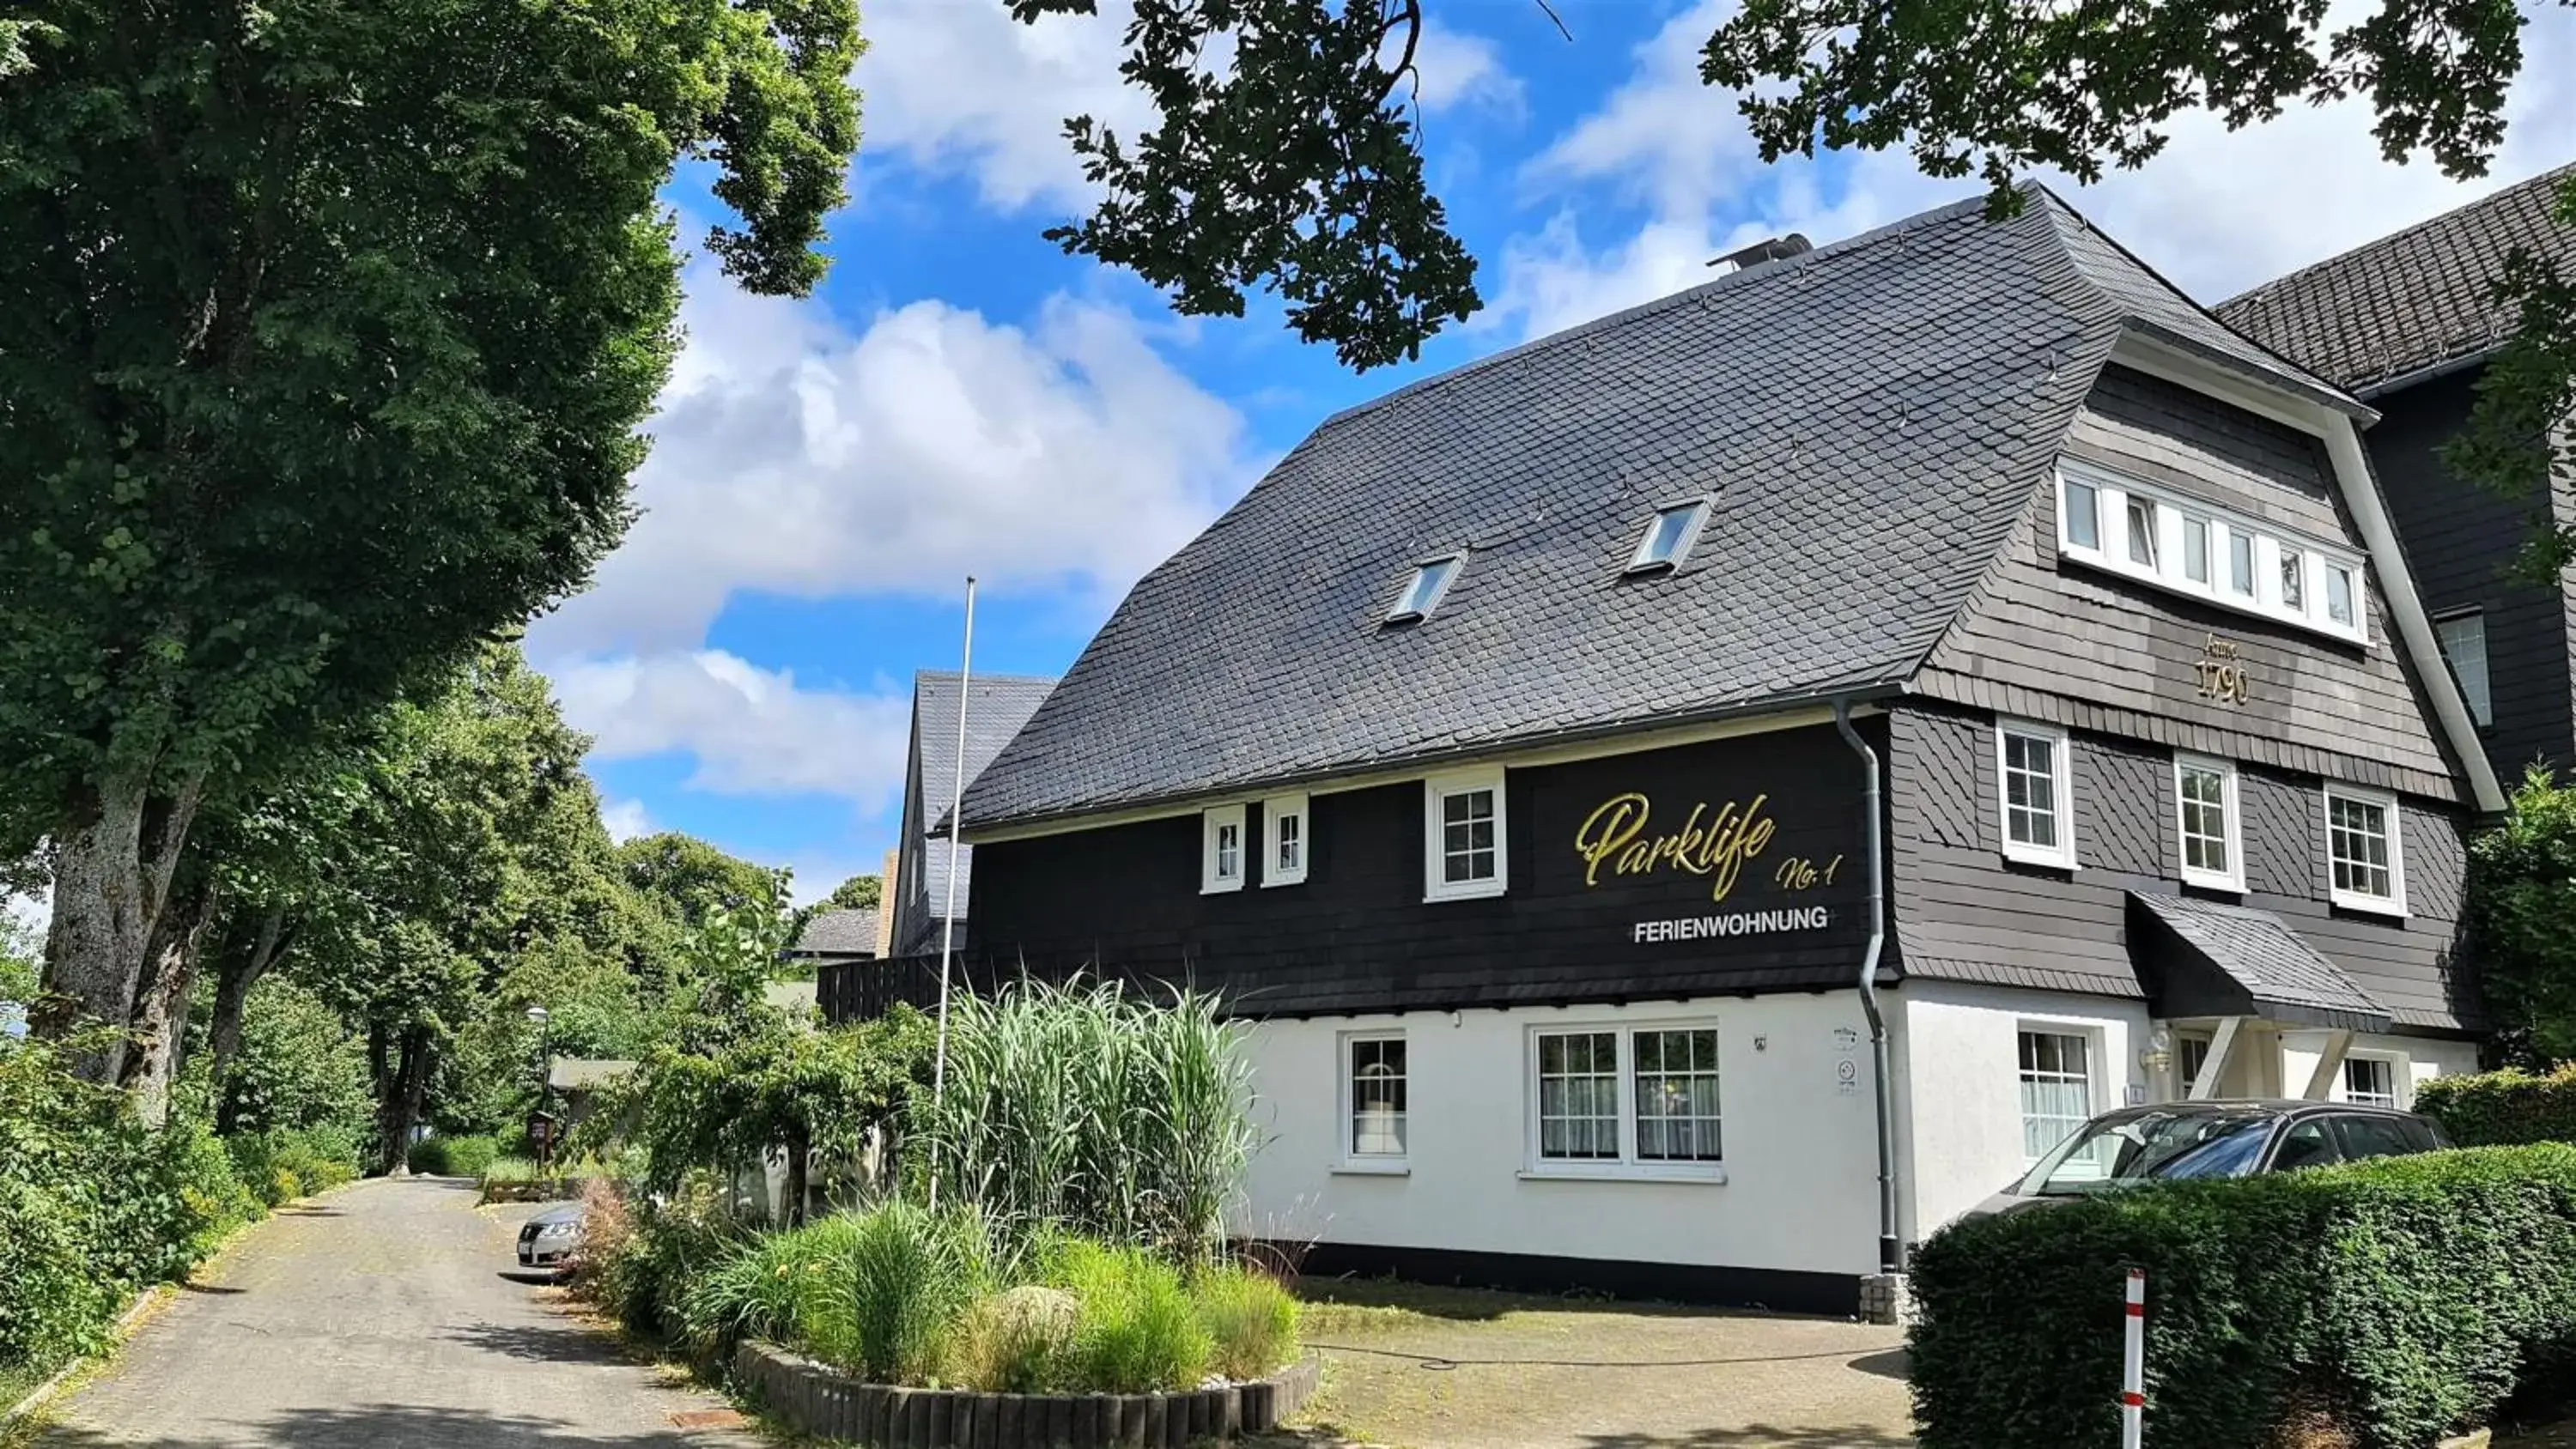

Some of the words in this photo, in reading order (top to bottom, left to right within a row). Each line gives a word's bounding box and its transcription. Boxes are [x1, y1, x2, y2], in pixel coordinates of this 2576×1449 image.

[2195, 660, 2249, 704] 1790
[1575, 792, 1776, 901] Parklife
[1775, 857, 1818, 889] No.
[1634, 906, 1828, 943] FERIENWOHNUNG
